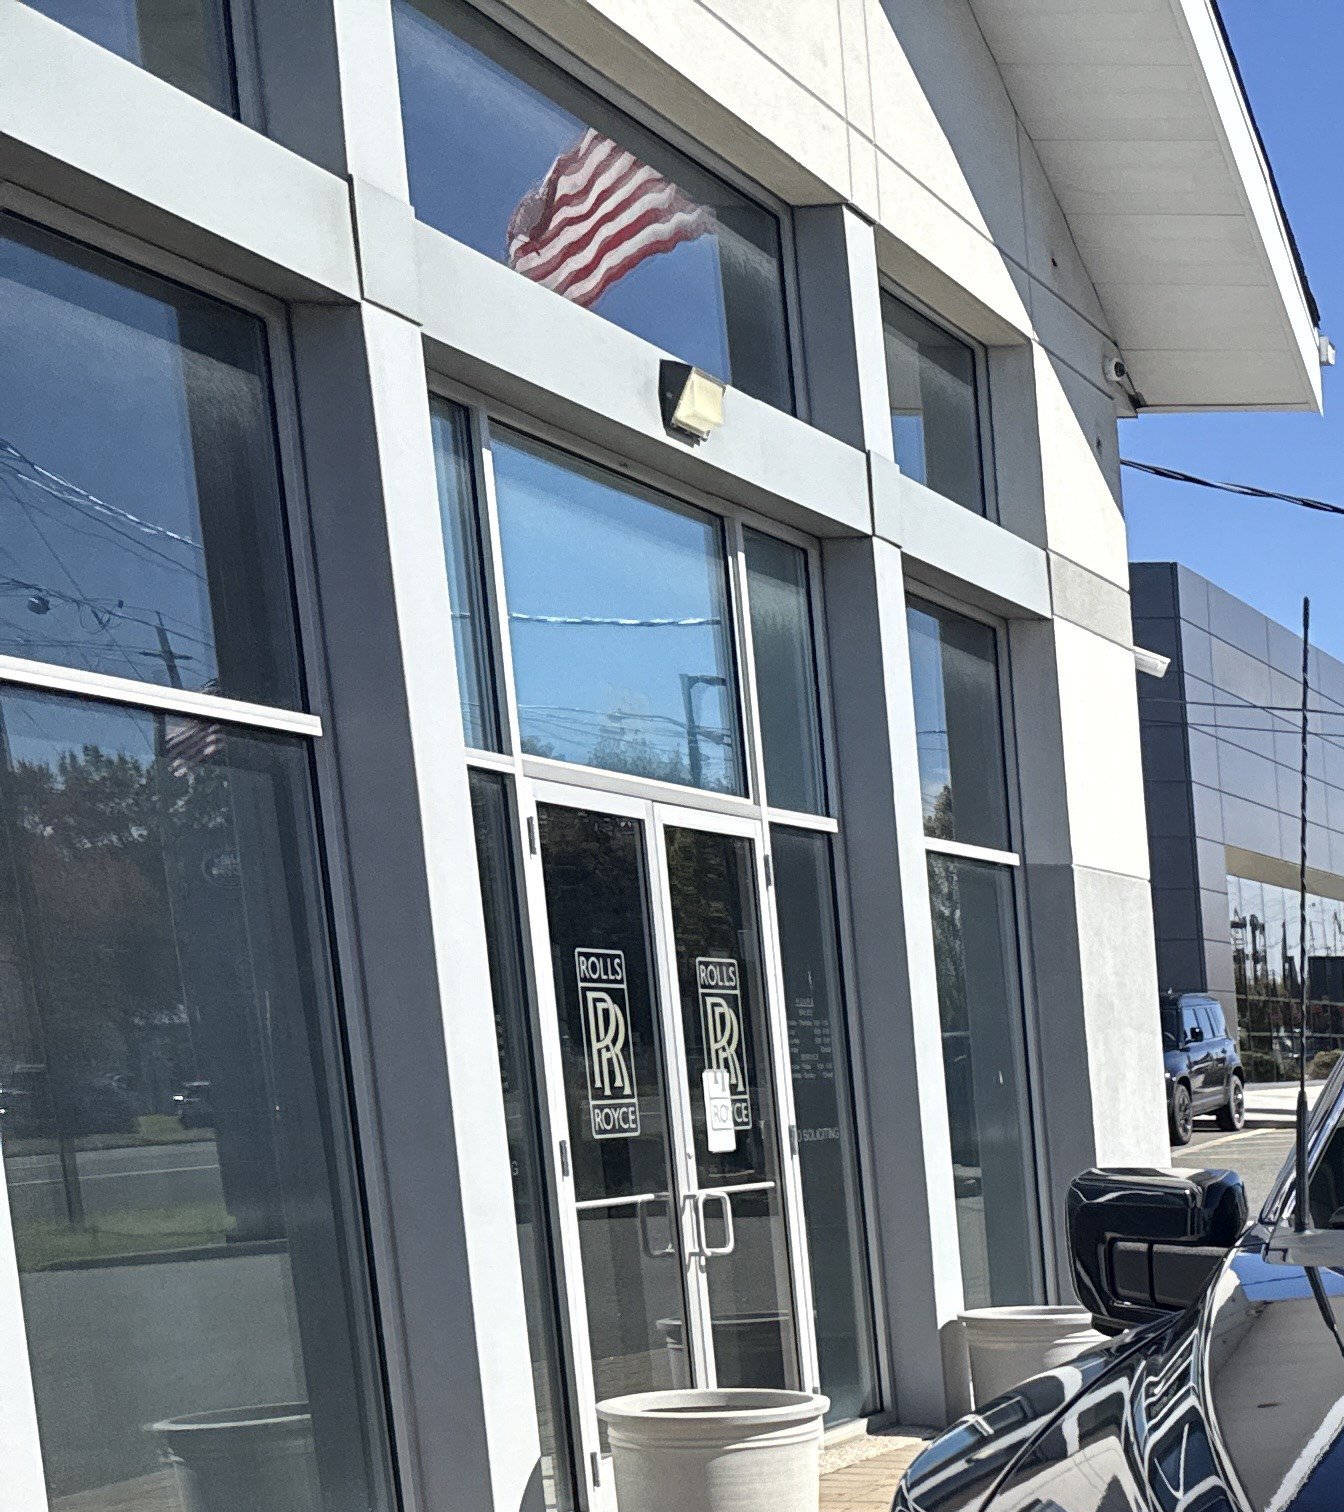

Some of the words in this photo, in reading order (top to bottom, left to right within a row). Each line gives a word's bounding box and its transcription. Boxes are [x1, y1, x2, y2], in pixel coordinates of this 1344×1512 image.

[579, 956, 622, 980] ROLLS
[700, 964, 736, 987] ROLLS
[594, 1107, 637, 1131] ROYCE
[712, 1102, 749, 1123] ROCE
